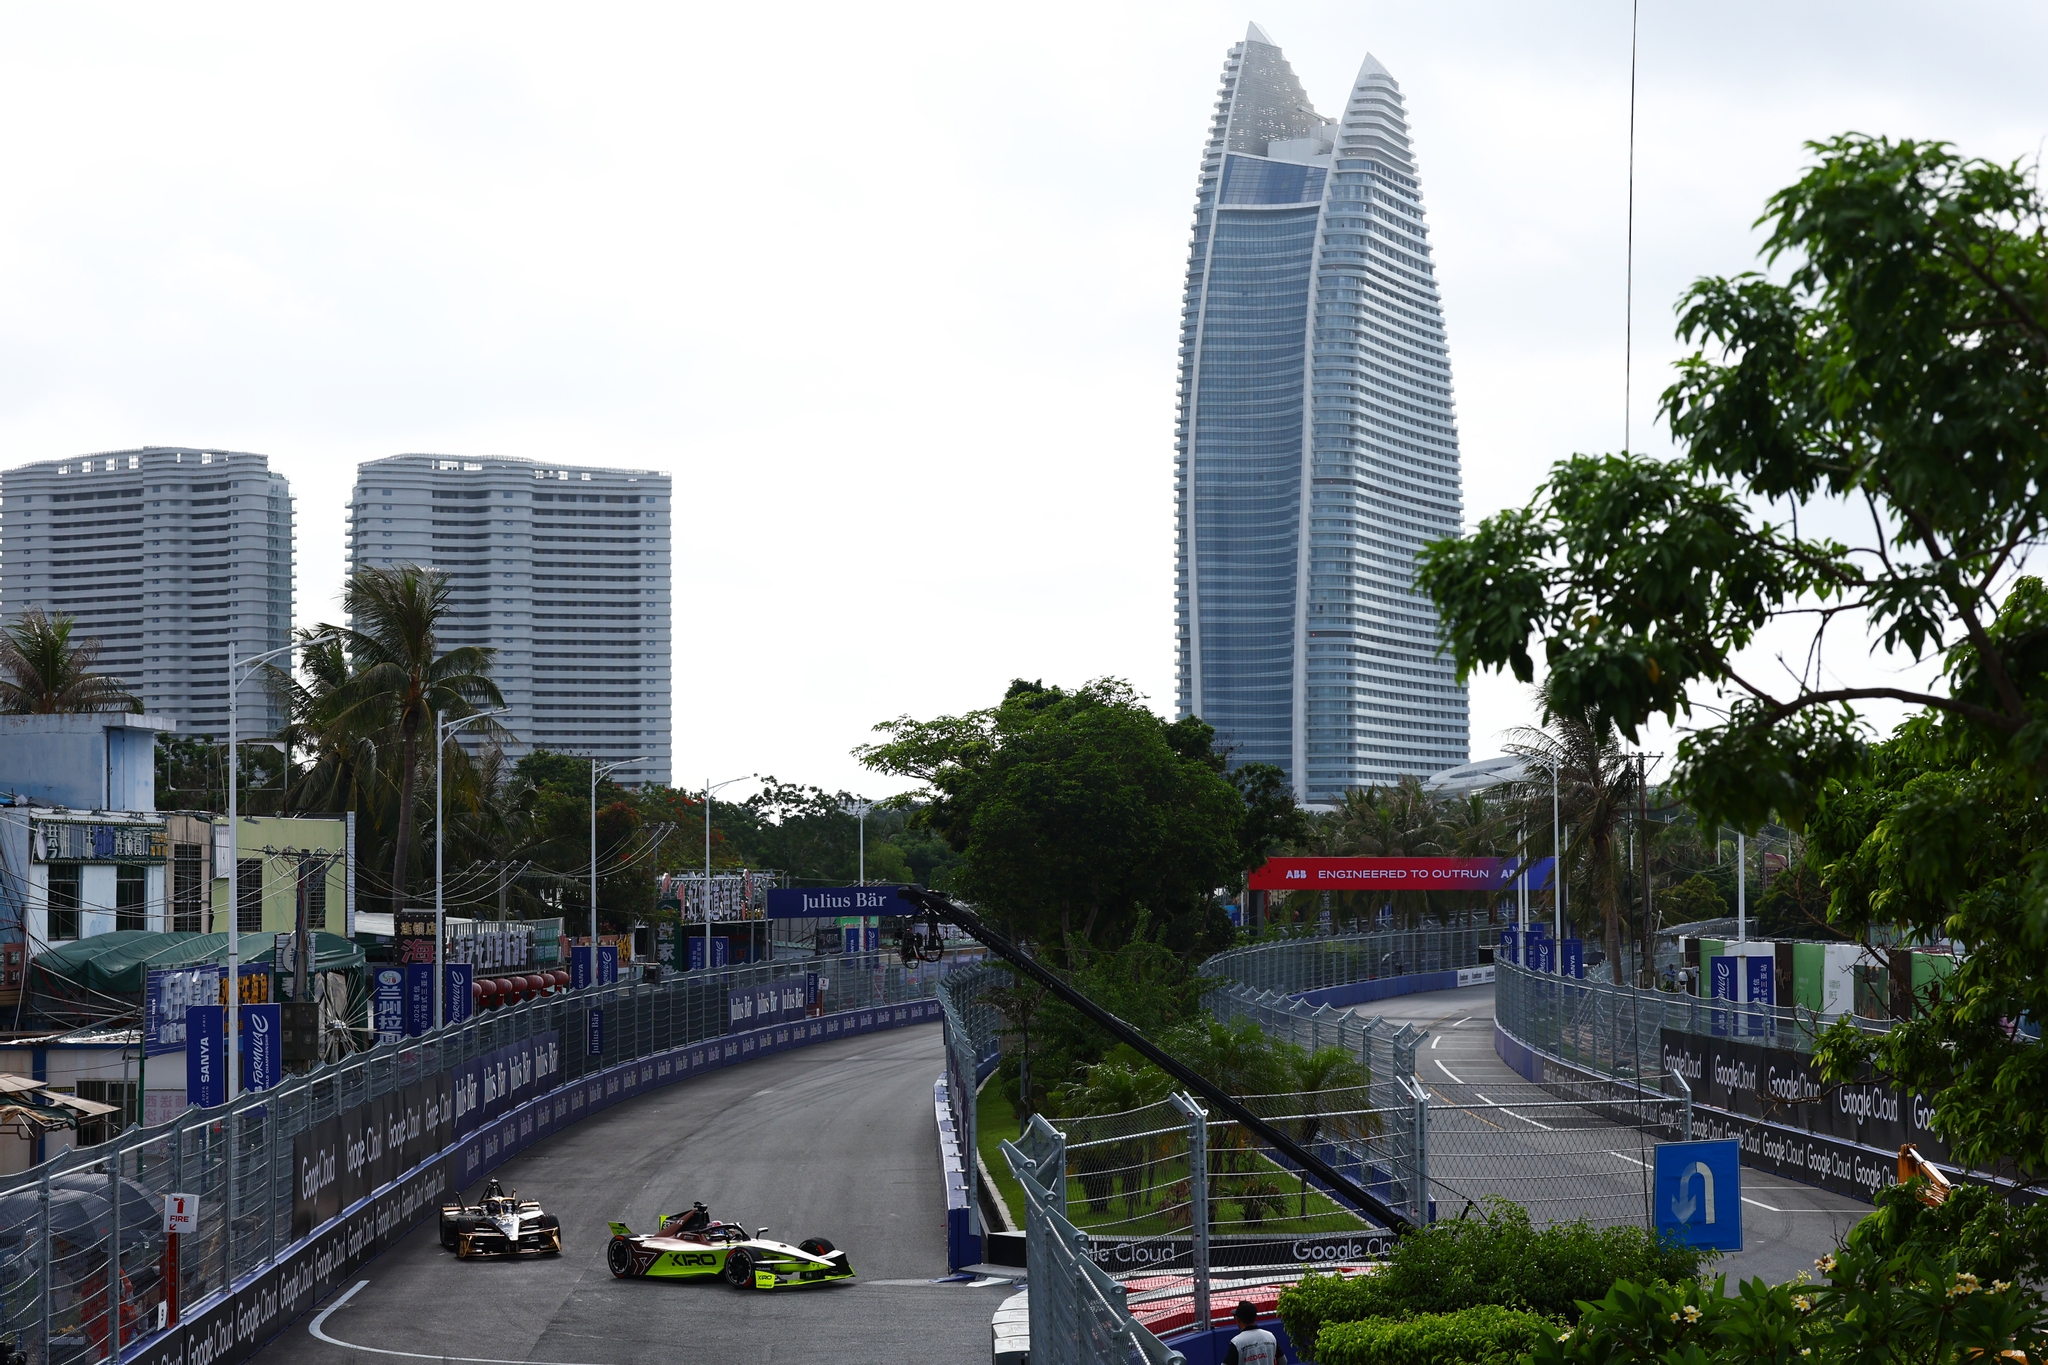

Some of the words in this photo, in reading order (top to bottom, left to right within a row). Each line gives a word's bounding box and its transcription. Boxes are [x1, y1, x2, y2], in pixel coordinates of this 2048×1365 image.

[1286, 870, 1307, 879] ABB
[1318, 870, 1407, 879] ENGINEERED
[1410, 870, 1429, 879] TO
[1432, 869, 1489, 878] OUTRUN
[802, 894, 850, 912] Julius
[856, 892, 886, 907] Bär
[200, 1037, 210, 1083] SANYA
[252, 1031, 264, 1085] FORMULA
[592, 1030, 600, 1053] Julius
[1664, 1044, 1684, 1078] Google
[1684, 1052, 1702, 1079] Cloud
[1714, 1055, 1739, 1095] Google
[1739, 1061, 1756, 1091] Cloud
[1839, 1086, 1872, 1125] Google
[1872, 1086, 1898, 1122] Cloud
[1708, 1119, 1724, 1139] Cloud
[1744, 1128, 1761, 1155] Cloud
[1763, 1133, 1785, 1166] Google
[1786, 1138, 1804, 1166] Cloud
[1807, 1144, 1832, 1180] Google
[1832, 1148, 1851, 1180] Cloud
[1855, 1155, 1881, 1194] Google
[1882, 1163, 1898, 1186] Clou
[376, 1201, 390, 1240] Google
[390, 1196, 400, 1227] Cloud
[401, 1186, 414, 1222] Google
[414, 1179, 424, 1210] Cloud
[348, 1219, 362, 1260] Google
[362, 1212, 374, 1244] Cloud
[1115, 1243, 1175, 1263] Cloud
[1292, 1239, 1363, 1264] Google
[315, 1241, 332, 1284] Google
[333, 1232, 346, 1269] Cloud
[280, 1266, 298, 1311] Google
[299, 1254, 314, 1294] Cloud
[237, 1293, 259, 1343] Google
[260, 1281, 278, 1323] Cloud
[214, 1311, 234, 1357] Cloud
